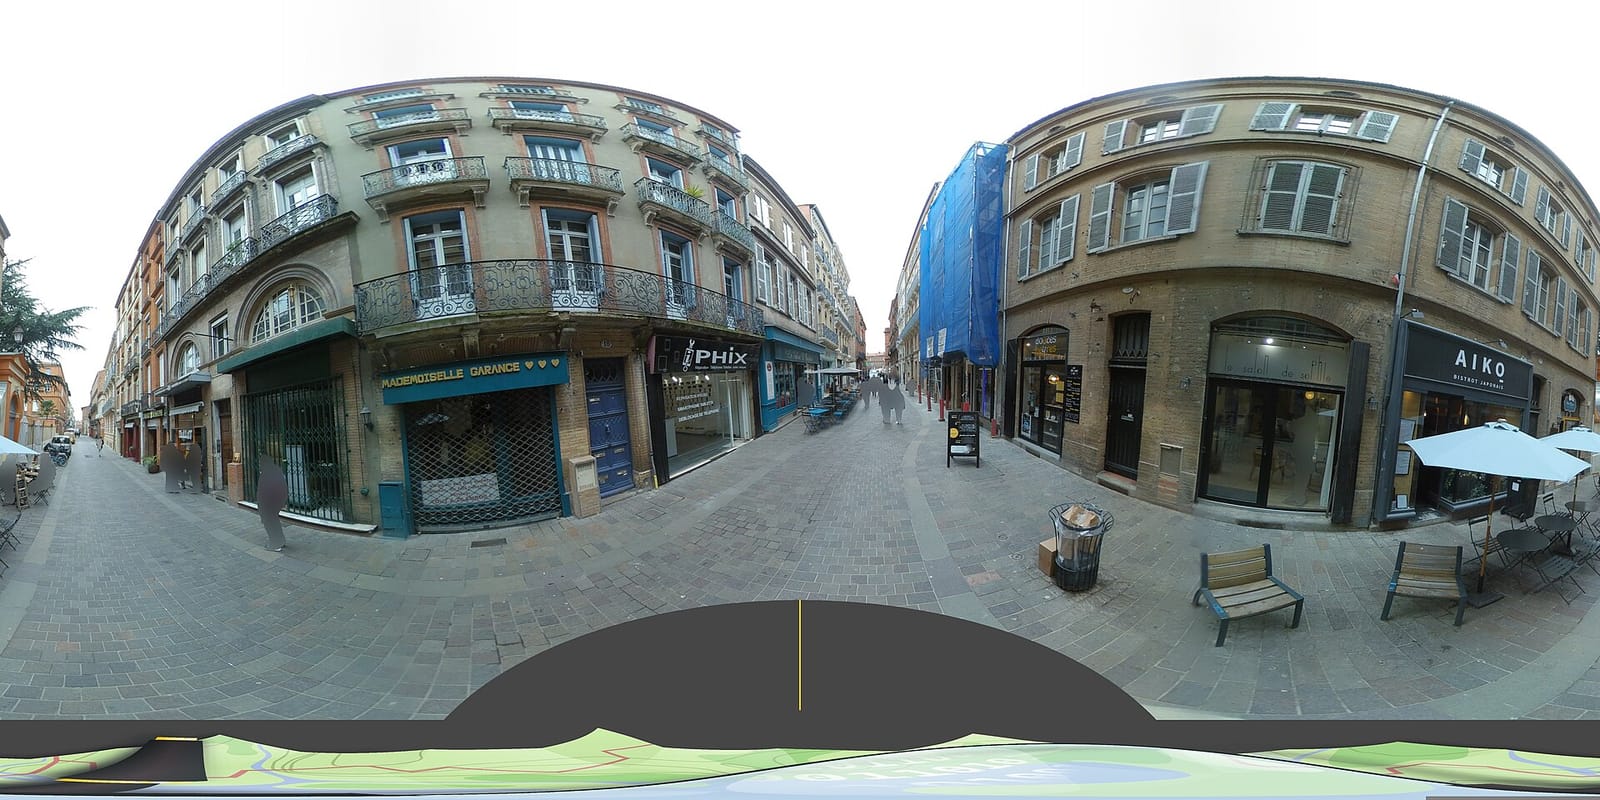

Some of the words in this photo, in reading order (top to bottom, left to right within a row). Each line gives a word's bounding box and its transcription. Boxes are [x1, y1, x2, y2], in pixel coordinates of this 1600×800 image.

[1281, 362, 1294, 378] de
[1454, 349, 1505, 378] AIKO
[382, 368, 464, 389] MADEMOISELLE
[470, 361, 520, 377] GARANCE
[1453, 374, 1478, 384] BISTROT
[1480, 380, 1504, 390] JAPONAIS
